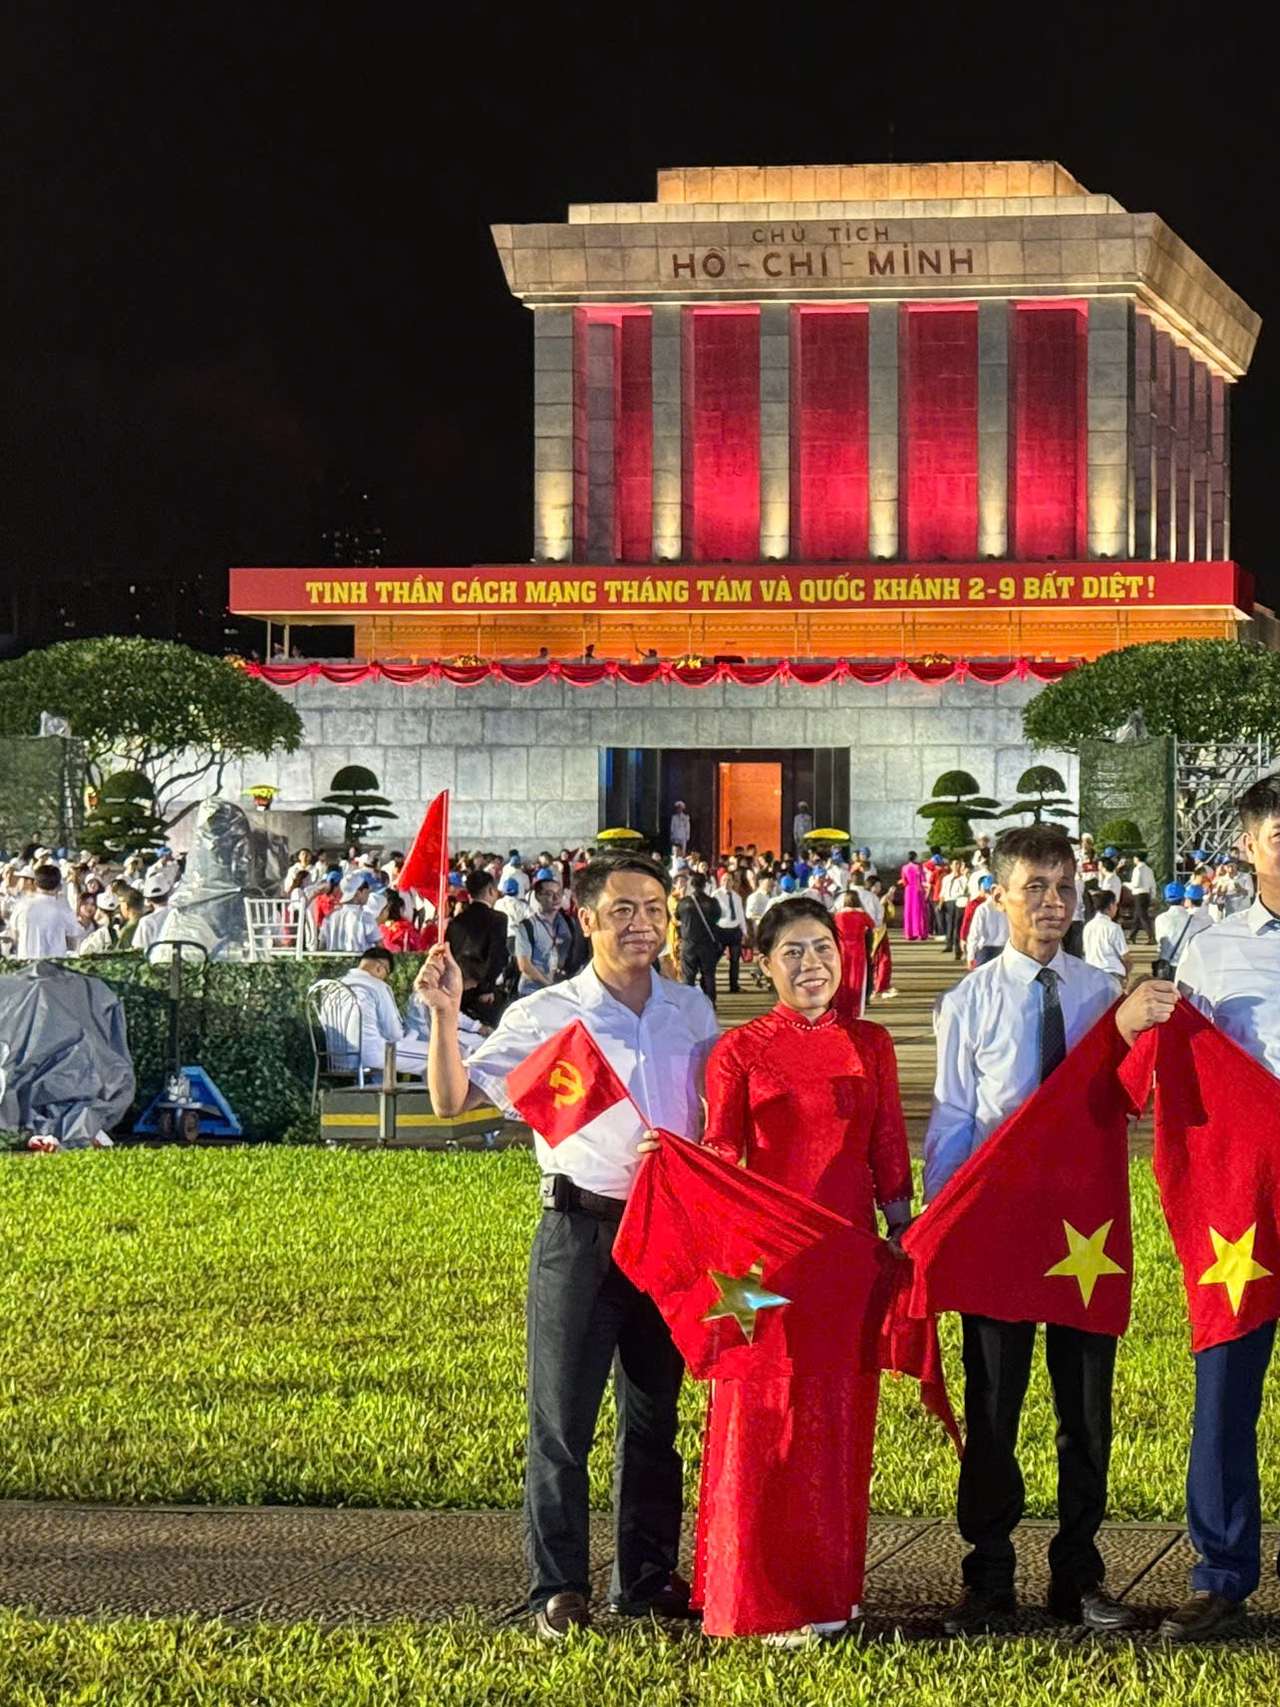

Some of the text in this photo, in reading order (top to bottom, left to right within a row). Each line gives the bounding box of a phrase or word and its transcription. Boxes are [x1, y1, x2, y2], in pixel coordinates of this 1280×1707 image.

[305, 581, 368, 604] TINH
[374, 574, 445, 604] THẦN
[451, 577, 518, 604] CÁCH
[524, 580, 597, 607] MẠNG
[603, 576, 690, 603] THÁNG
[696, 576, 752, 603] TÁM
[759, 575, 793, 602] VÀ
[799, 572, 866, 604] QUỐC
[873, 574, 961, 601] KHÁNH
[968, 577, 1016, 601] 2-9
[1022, 570, 1076, 600] BẤT
